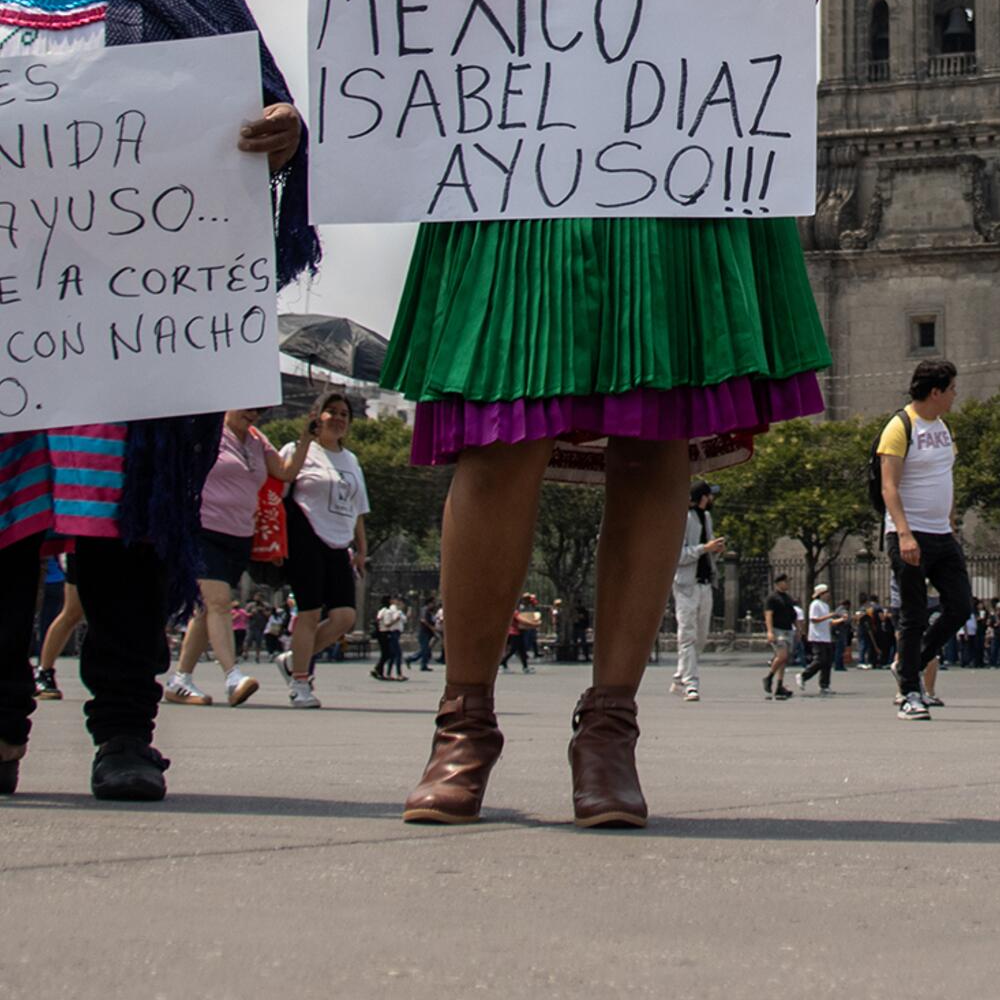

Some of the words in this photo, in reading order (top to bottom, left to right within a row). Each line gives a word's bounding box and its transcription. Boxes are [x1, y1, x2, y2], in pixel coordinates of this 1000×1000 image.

[318, 61, 577, 145] ISABEL
[624, 54, 792, 138] DIAZ
[426, 139, 776, 215] AYUSO!!!
[58, 264, 83, 301] A
[108, 253, 270, 298] CORTÉS
[7, 321, 85, 363] CON
[109, 305, 266, 361] NACHO
